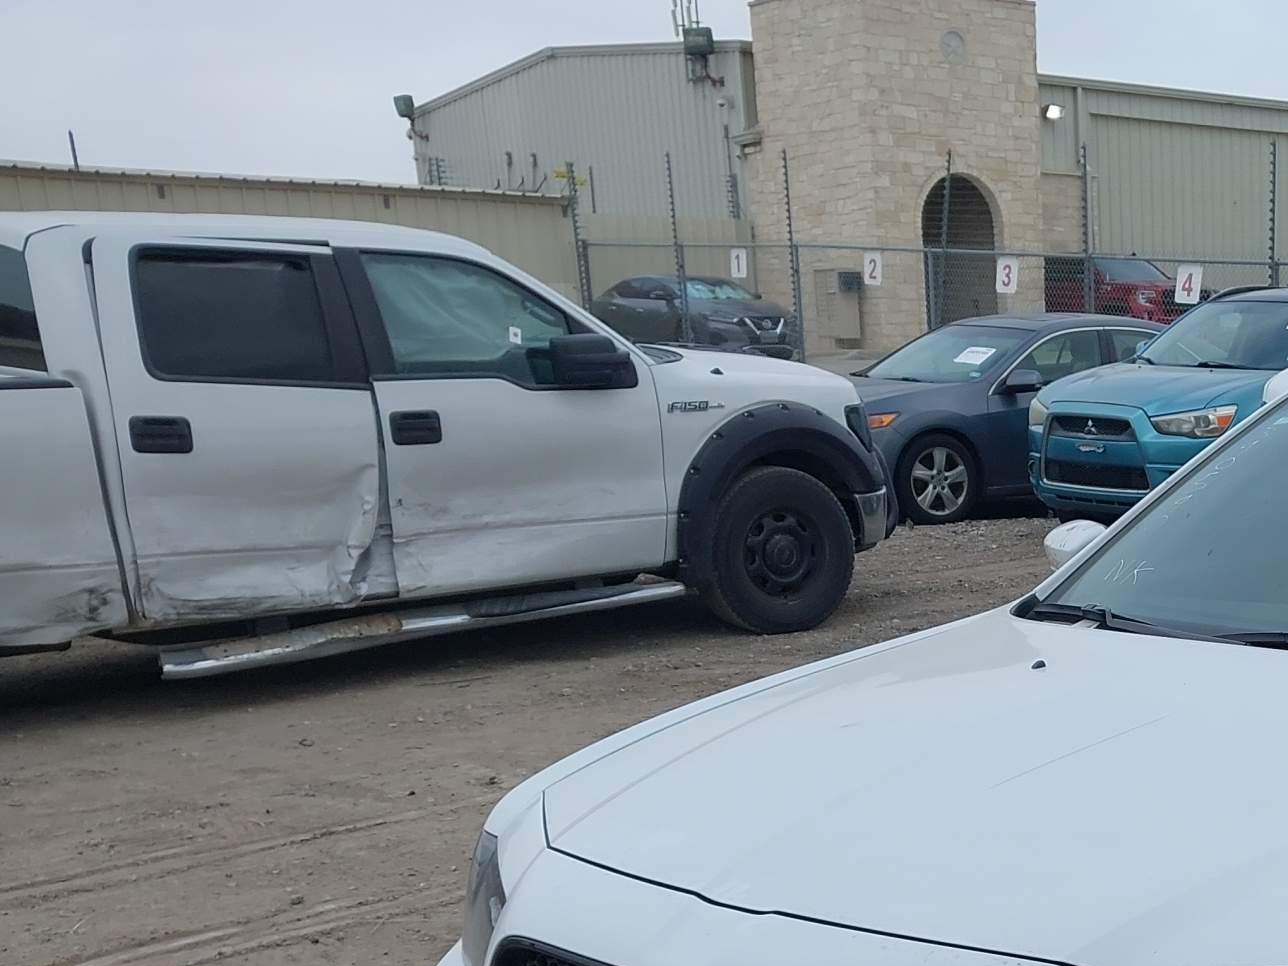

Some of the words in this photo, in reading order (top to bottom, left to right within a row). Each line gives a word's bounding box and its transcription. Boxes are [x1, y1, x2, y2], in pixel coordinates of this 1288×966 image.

[868, 258, 877, 279] 2
[1002, 264, 1012, 287] 3
[1181, 272, 1193, 297] 4
